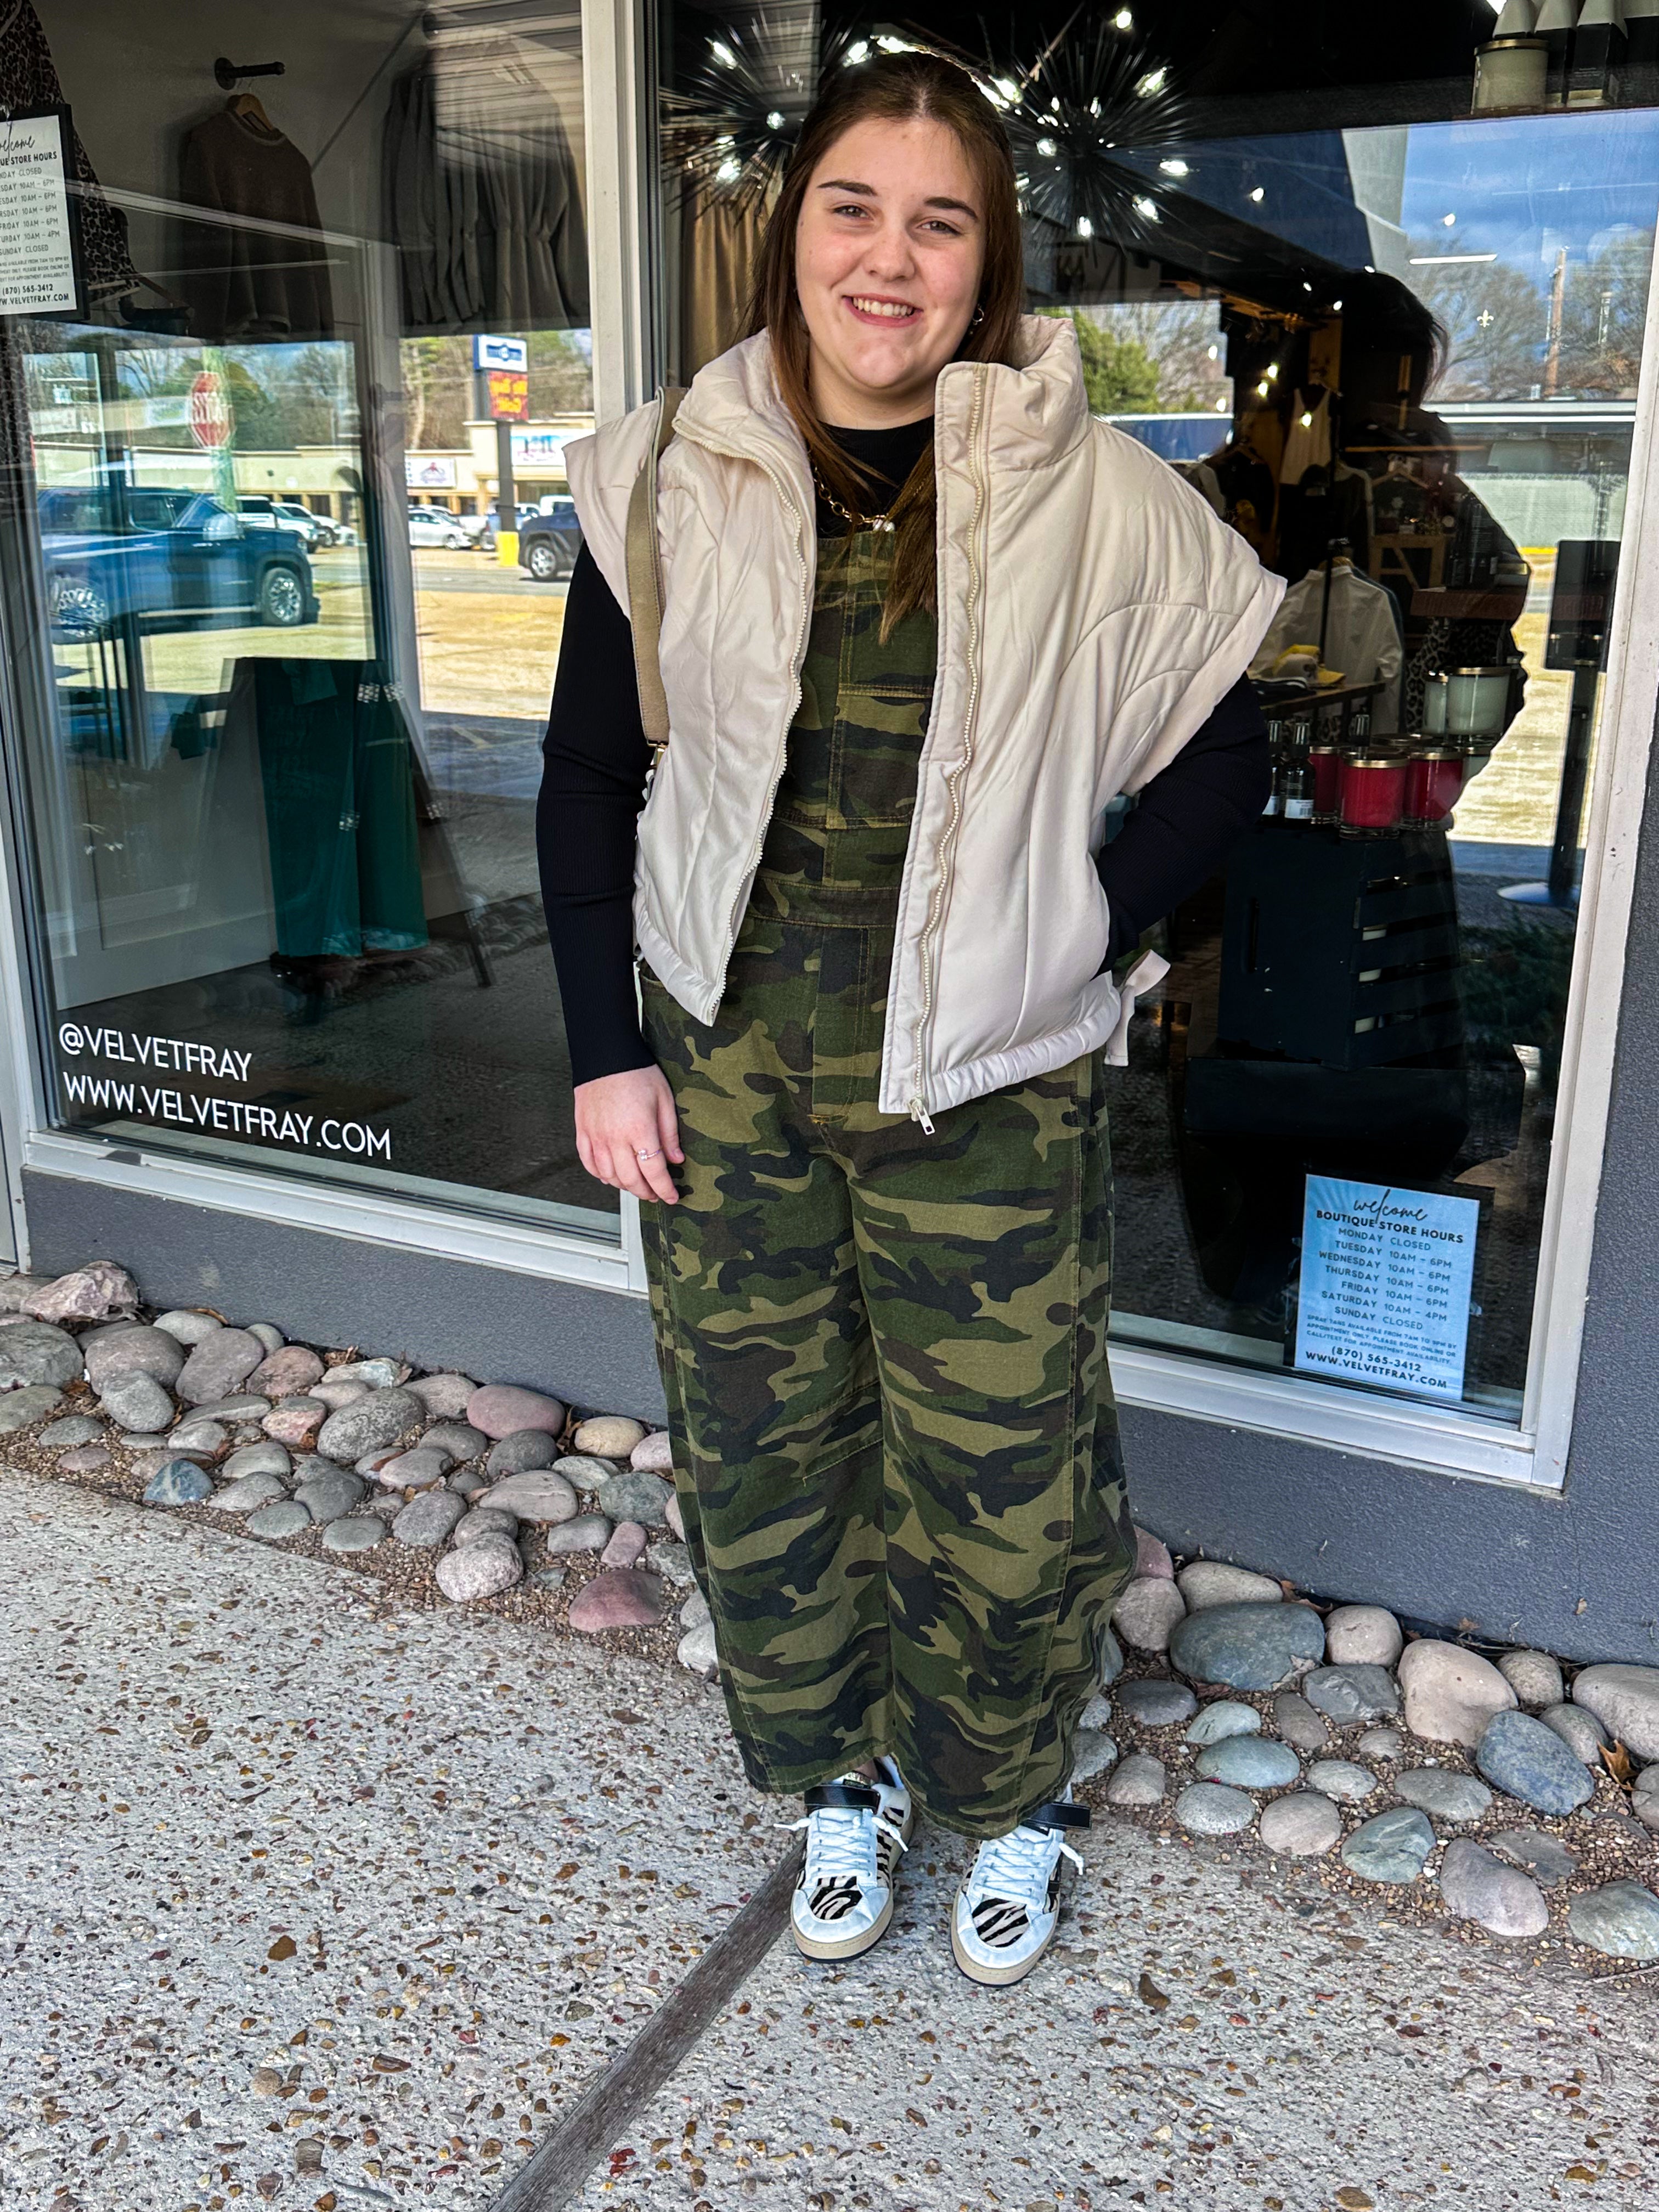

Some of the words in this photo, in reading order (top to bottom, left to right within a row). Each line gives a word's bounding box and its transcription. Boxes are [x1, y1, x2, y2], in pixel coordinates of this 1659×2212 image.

[10, 154, 32, 165] STORE
[33, 151, 57, 161] HOURS
[18, 167, 42, 177] CLOSED
[0, 183, 16, 192] SDAY
[20, 181, 35, 189] 10AM
[21, 194, 37, 202] 10AM
[0, 208, 18, 217] RSDAY
[22, 206, 38, 215] 10AM
[25, 244, 49, 253] CLOSED
[0, 293, 69, 306] W.VELVETFRAY.COM
[2, 286, 21, 296] (870)
[22, 283, 54, 293] 565-3412
[59, 1022, 252, 1082] @VELVETFRAY
[63, 1071, 391, 1160] WWW.VELVETFRAY.COM
[1353, 1189, 1428, 1224] welcome
[1317, 1210, 1374, 1227] BOUTIQUE
[1379, 1221, 1417, 1235] STORE
[1421, 1228, 1464, 1243] HOURS
[1338, 1227, 1383, 1243] MONDAY
[1390, 1237, 1431, 1251] CLOSED
[1319, 1250, 1381, 1269] WEDNESDAY
[1387, 1263, 1415, 1275] 10AM
[1428, 1271, 1451, 1282] 6PM
[1335, 1240, 1383, 1255] TUESDAY
[1389, 1250, 1416, 1262] 10AM
[1430, 1257, 1452, 1268] 6PM
[1325, 1265, 1380, 1282] THURSDAY
[1386, 1277, 1413, 1288] 10AM
[1427, 1284, 1449, 1295] 6PM
[1321, 1290, 1378, 1307] SATURDAY
[1384, 1303, 1411, 1314] 10AM
[1425, 1311, 1447, 1322] 4PM
[1341, 1281, 1378, 1295] FRIDAY
[1385, 1290, 1412, 1301] 10AM
[1426, 1297, 1448, 1308] 6PM
[1329, 1318, 1345, 1327] TANS
[1347, 1322, 1382, 1334] AVAILABLE
[1384, 1330, 1402, 1338] FROM
[1334, 1306, 1376, 1321] SUNDAY
[1383, 1316, 1423, 1330] CLOSED
[1307, 1322, 1350, 1336] APPOINTMENT
[1373, 1335, 1397, 1345] PLEASE
[1399, 1341, 1419, 1350] BOOK
[1359, 1341, 1404, 1355] APPOINTMENT
[1306, 1351, 1447, 1389] WWW.VELVETFRAY.COM
[1331, 1346, 1363, 1361] (870)
[1367, 1353, 1421, 1372] 565-3412
